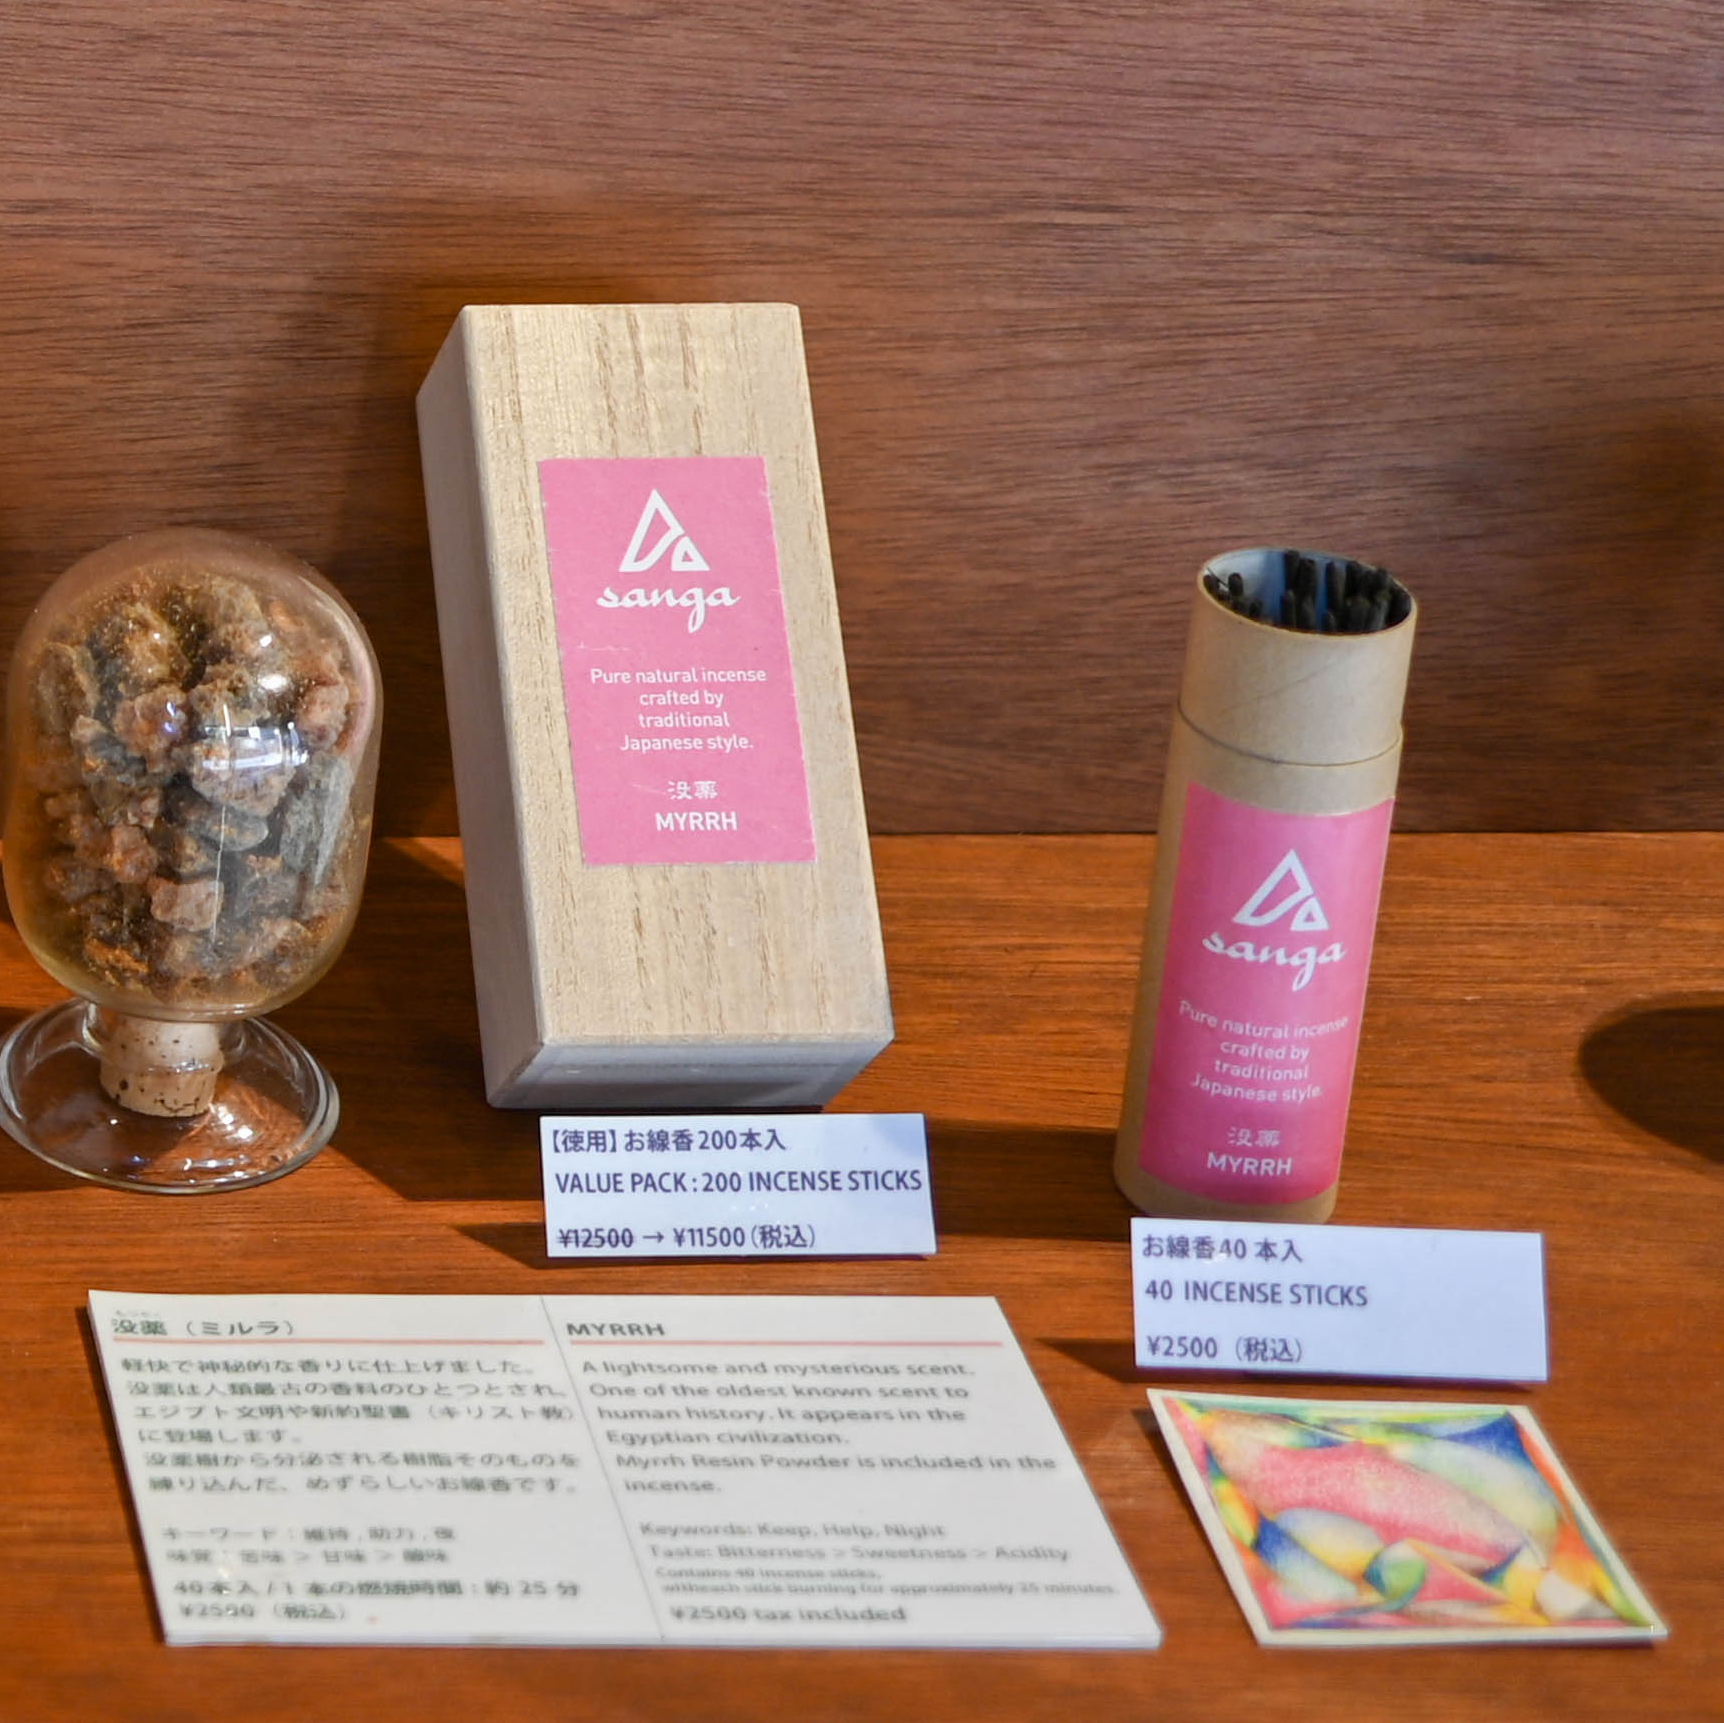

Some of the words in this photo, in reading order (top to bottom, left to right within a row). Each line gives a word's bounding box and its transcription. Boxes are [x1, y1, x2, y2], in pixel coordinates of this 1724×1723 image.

[596, 587, 741, 633] sanga
[591, 668, 631, 684] Pure
[636, 668, 698, 684] natural
[701, 668, 766, 682] incense
[640, 690, 700, 707] crafted
[704, 690, 724, 708] by
[639, 713, 730, 728] traditional
[620, 735, 703, 754] Japanese
[707, 734, 753, 753] style.
[655, 811, 737, 831] MYRRH
[1202, 932, 1346, 992] sanga
[1179, 1000, 1218, 1026] Pure
[1222, 1020, 1289, 1038] natural
[1294, 1016, 1349, 1038] incense
[1220, 1039, 1286, 1059] crafted
[1291, 1045, 1309, 1062] by
[1215, 1060, 1308, 1081] traditional
[1190, 1074, 1277, 1102] Japanese
[1207, 1151, 1292, 1176] MYRRH
[555, 1173, 624, 1193] VALUE
[749, 1170, 842, 1192] INCENSE
[848, 1170, 921, 1191] STICKS
[1145, 1280, 1173, 1300] 40
[1185, 1281, 1282, 1304] INCENSE
[1290, 1284, 1368, 1307] STICKS
[567, 1323, 665, 1336] MYRRH
[1147, 1336, 1217, 1358] ¥2500
[583, 1361, 597, 1372] A
[602, 1361, 718, 1376] lightsome
[726, 1362, 768, 1374] and
[774, 1360, 901, 1376] mysterious
[907, 1361, 974, 1375] scent.
[589, 1384, 636, 1396] One
[643, 1384, 665, 1396] of
[671, 1385, 709, 1396] the
[716, 1385, 787, 1396] oldest
[792, 1385, 871, 1397] known
[878, 1387, 939, 1398] scent
[944, 1387, 969, 1398] to
